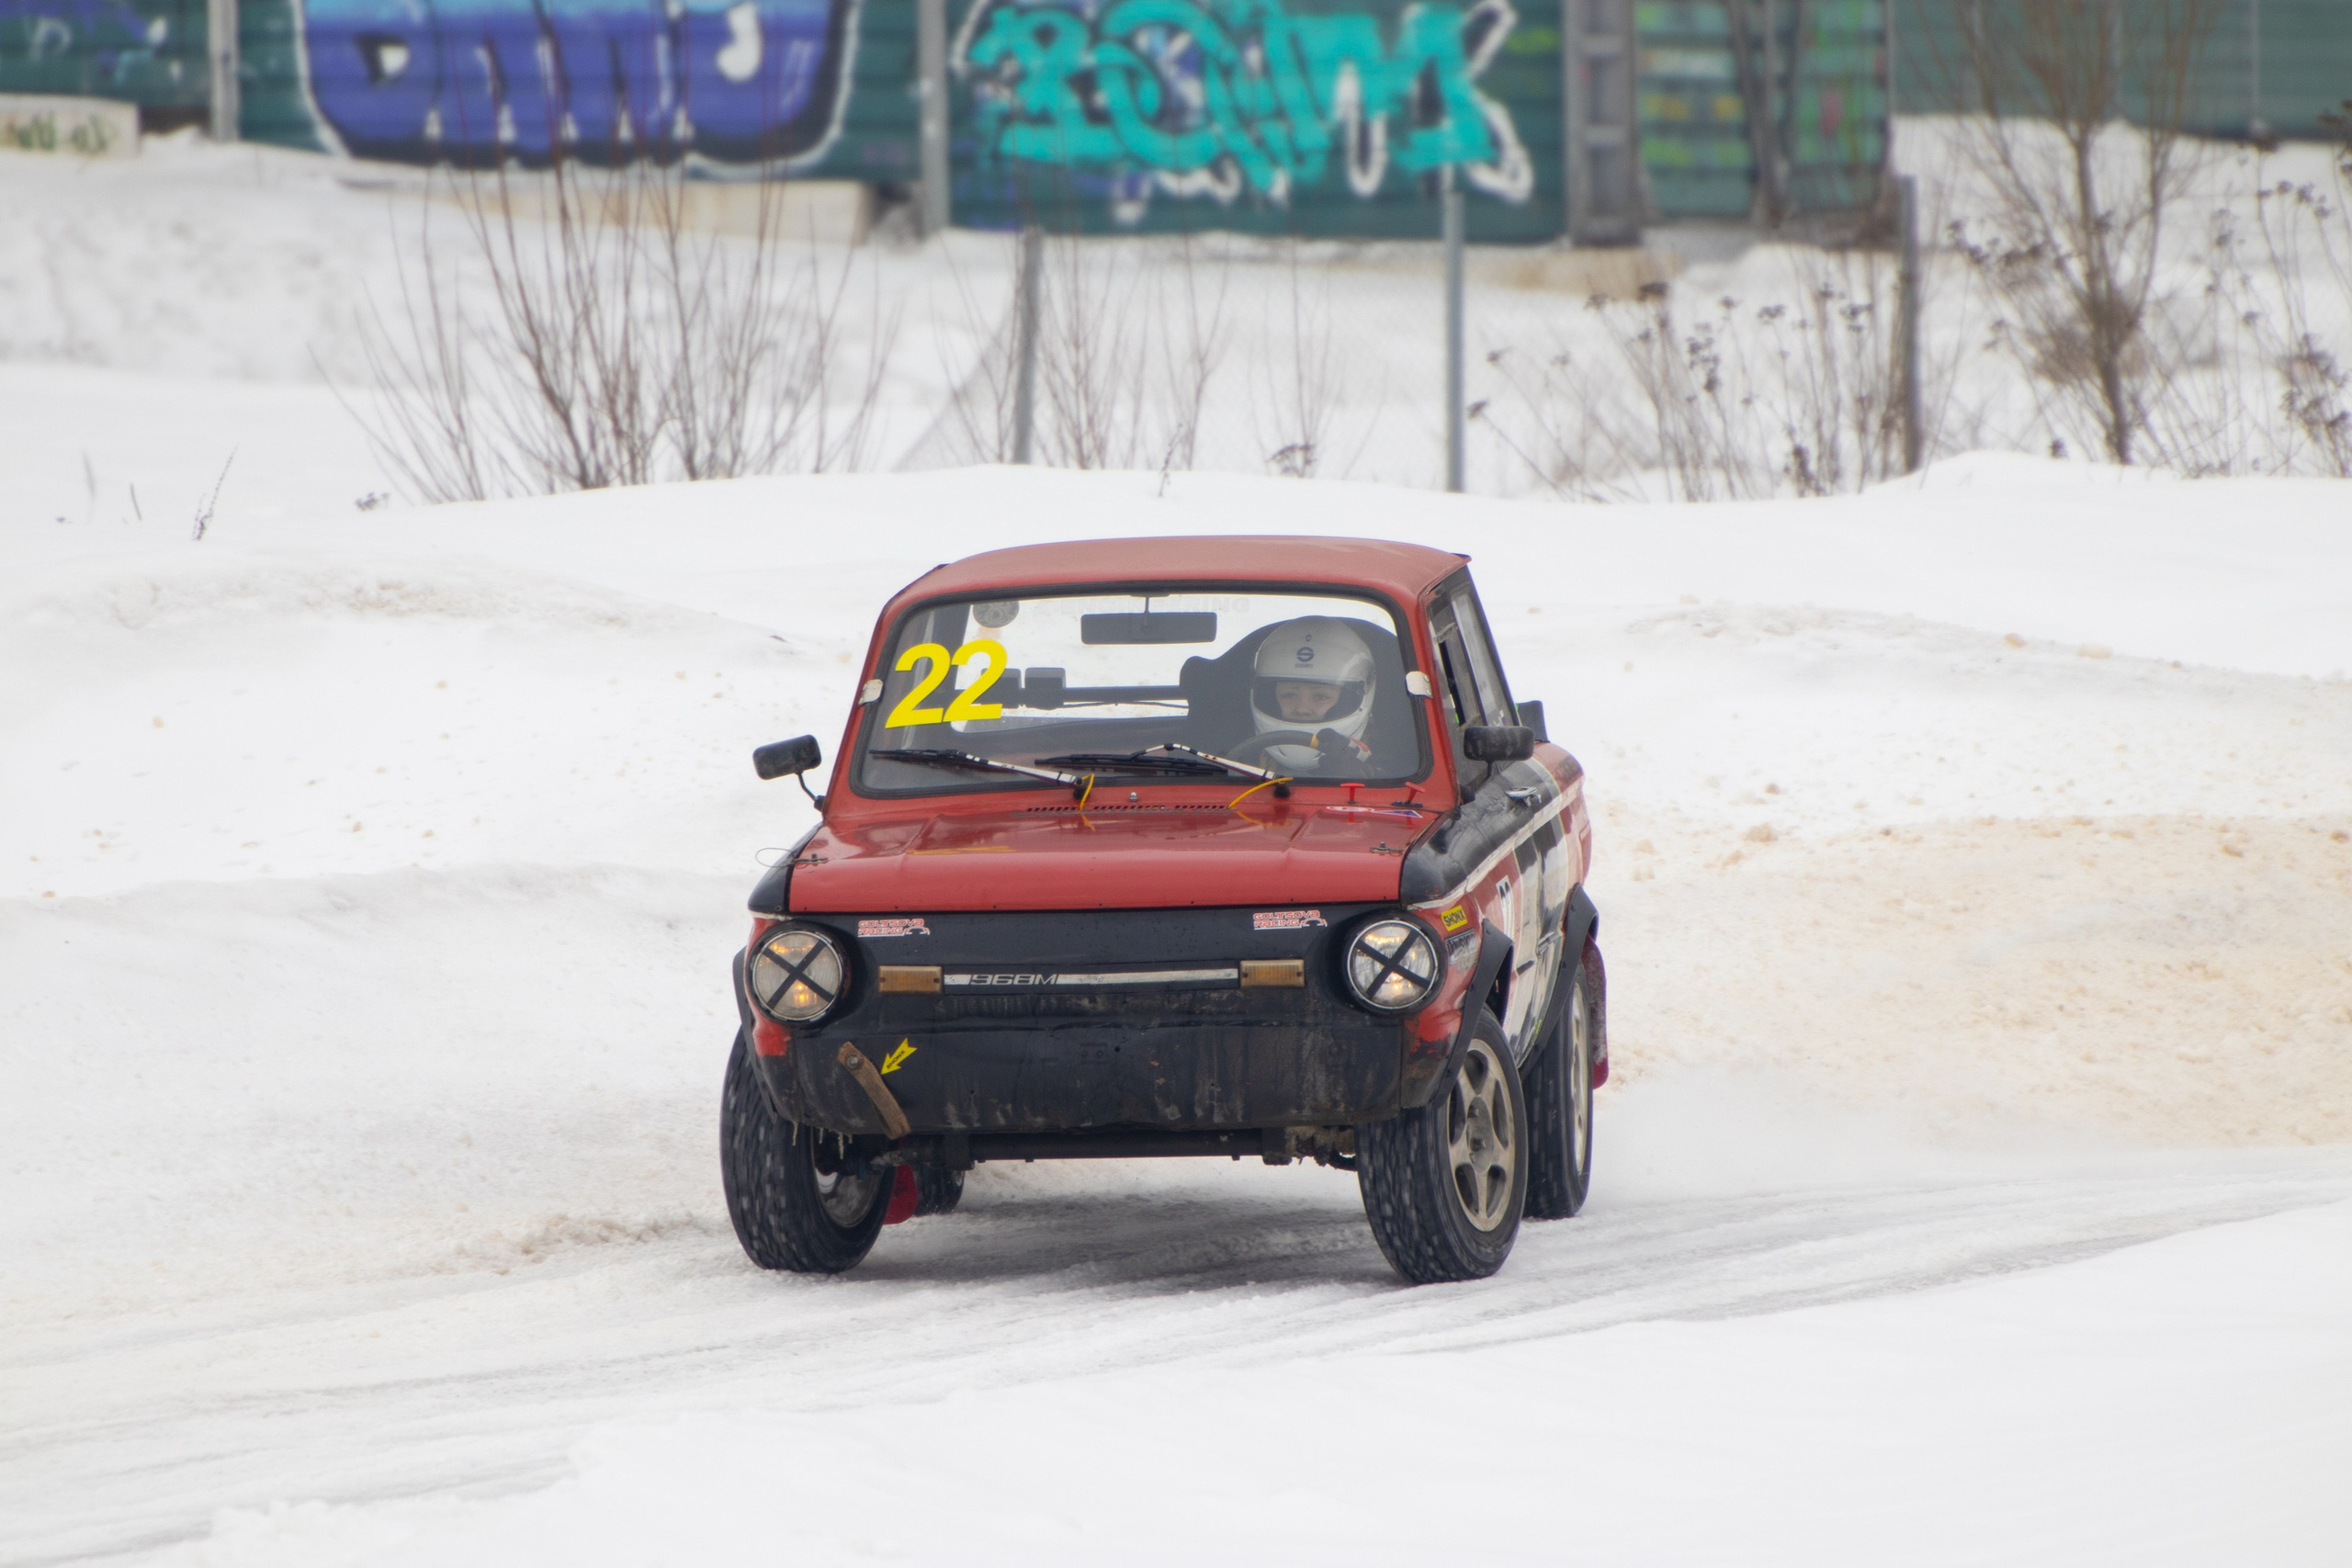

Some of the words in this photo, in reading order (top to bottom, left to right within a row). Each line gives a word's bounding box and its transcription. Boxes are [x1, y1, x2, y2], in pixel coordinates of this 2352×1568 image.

[885, 639, 1008, 728] 22
[1254, 919, 1300, 928] RACING
[1443, 908, 1466, 928] SHONX
[858, 927, 904, 935] RACING
[969, 974, 1057, 985] 968M
